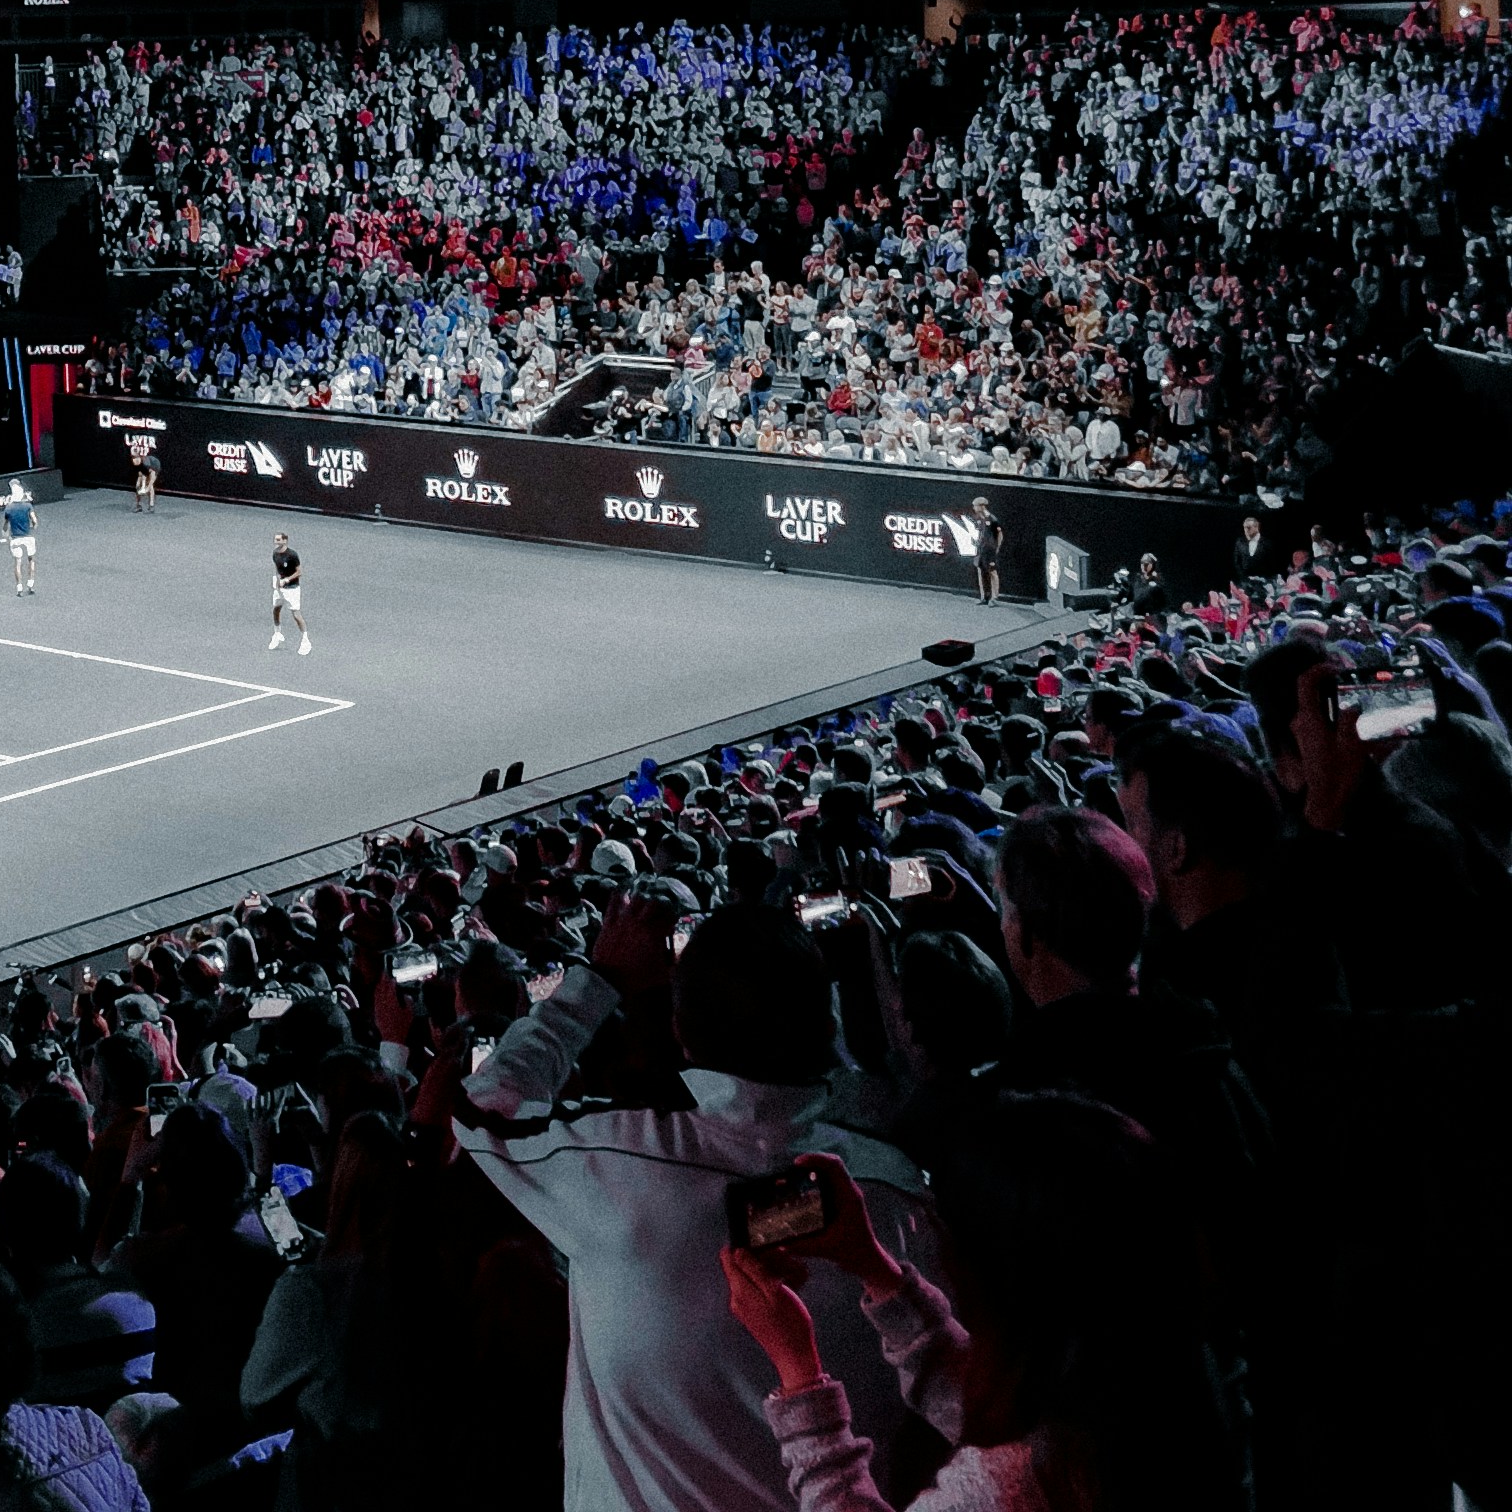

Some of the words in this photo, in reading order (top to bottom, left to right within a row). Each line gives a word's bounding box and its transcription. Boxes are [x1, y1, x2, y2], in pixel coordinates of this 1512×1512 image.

[26, 344, 61, 355] LAVER
[61, 343, 86, 355] CUP
[207, 442, 247, 459] CREDIT
[306, 445, 368, 472] LAVER
[214, 456, 248, 474] SUISSE
[425, 478, 511, 506] ROLEX
[604, 498, 699, 528] ROLEX
[765, 493, 846, 525] LAVER
[883, 514, 943, 535] CREDIT
[892, 533, 945, 553] SUISSE
